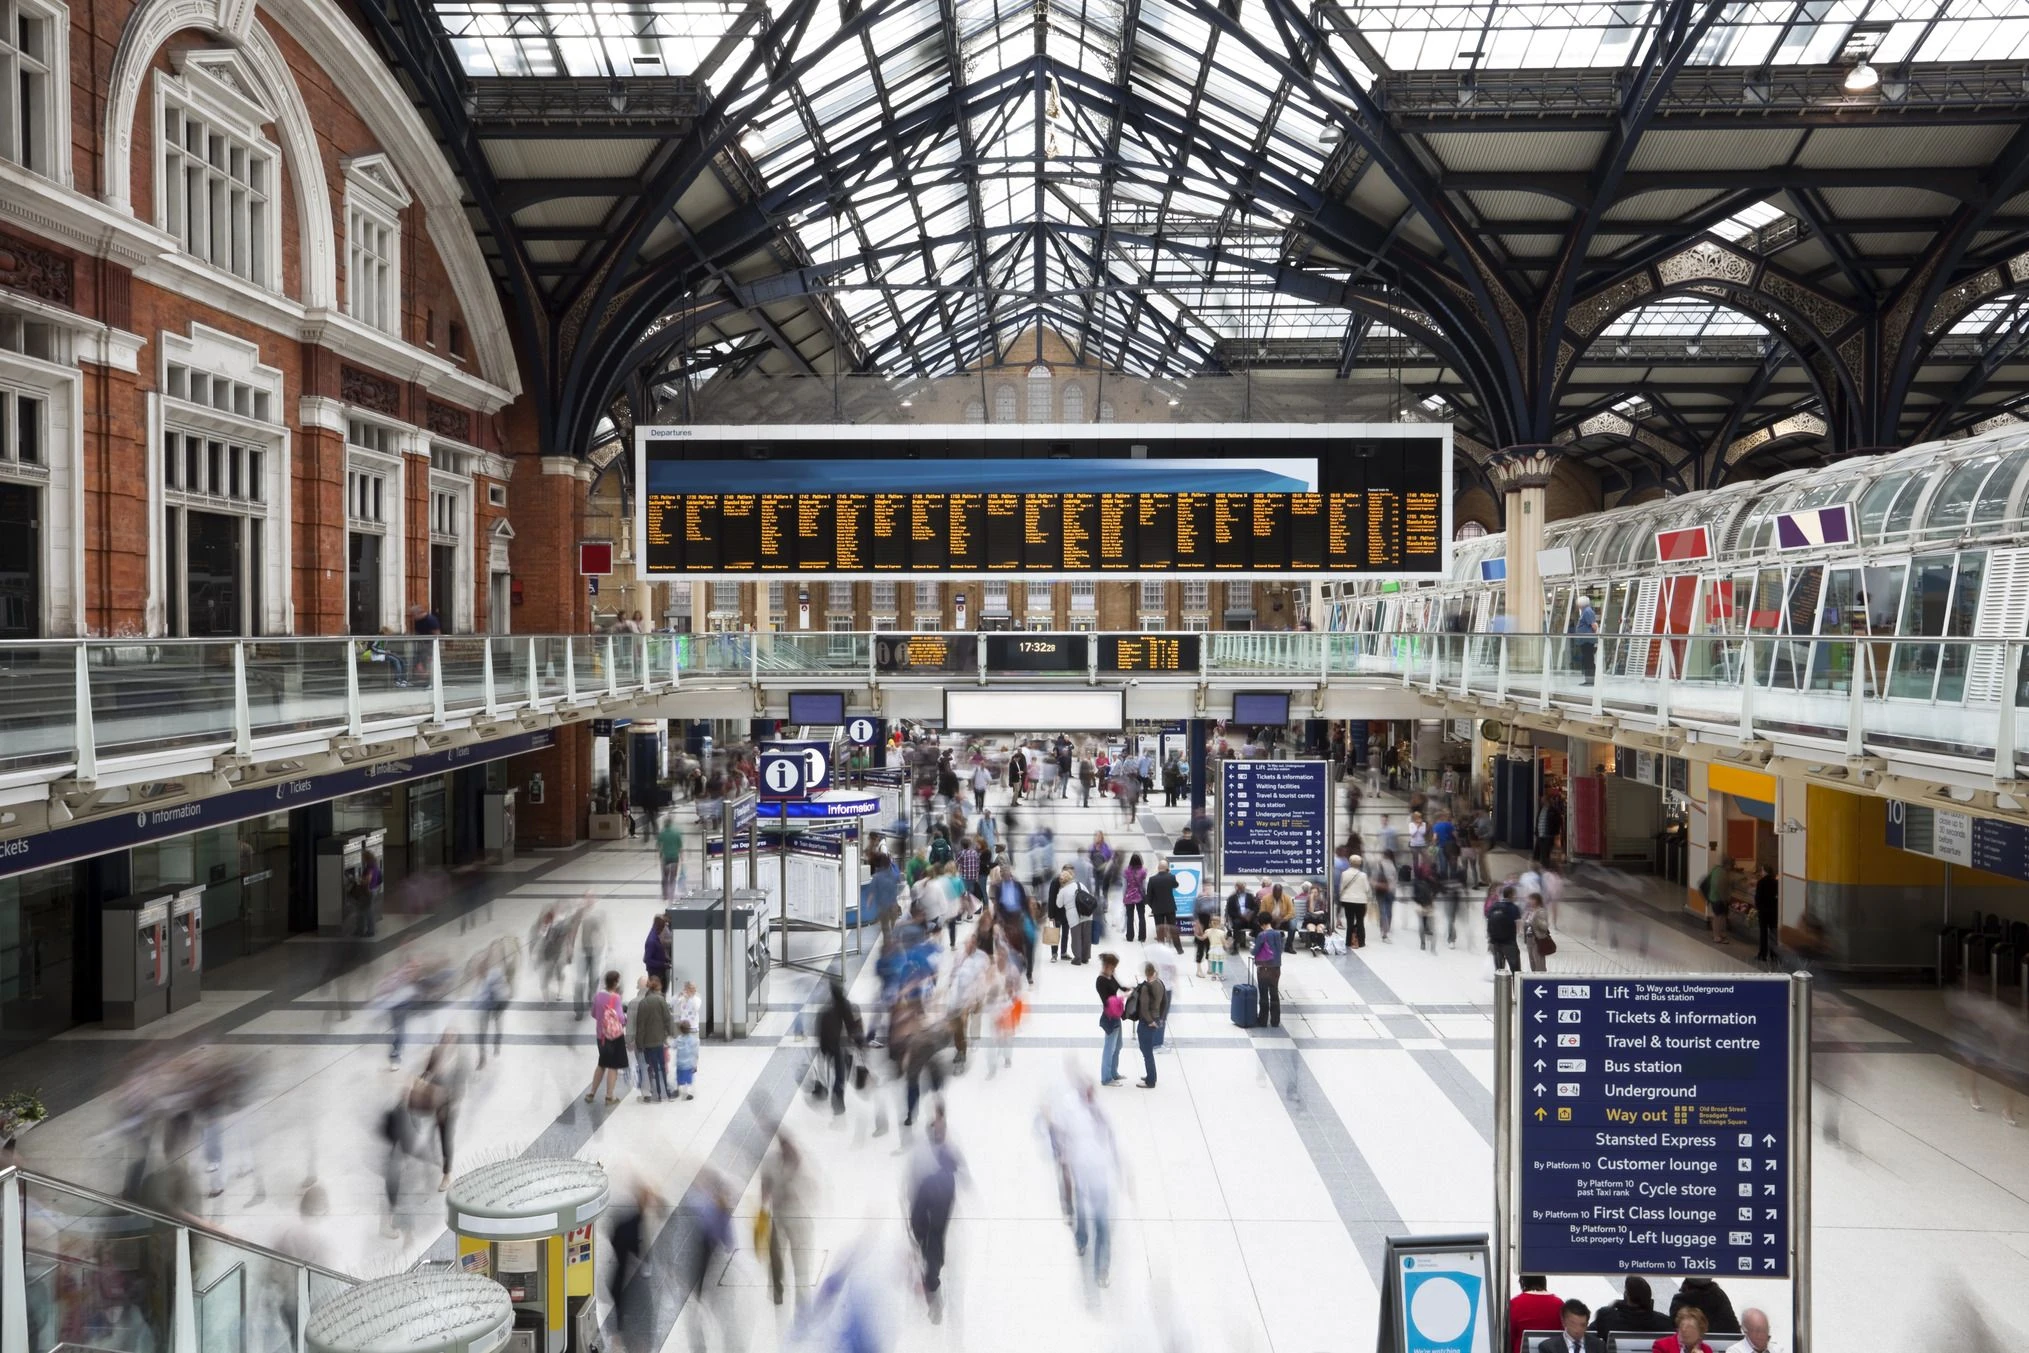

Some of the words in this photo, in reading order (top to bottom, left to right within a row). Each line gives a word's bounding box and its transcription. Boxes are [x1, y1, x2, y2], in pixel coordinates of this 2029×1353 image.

[651, 429, 692, 437] Departures
[289, 780, 312, 795] Tickets
[152, 802, 200, 825] Information
[828, 802, 874, 814] information
[1887, 800, 1902, 824] 10
[1946, 828, 1965, 838] seconds
[1939, 835, 1952, 845] before
[0, 838, 28, 858] ckets
[1939, 846, 1960, 856] departure
[1606, 986, 1629, 998] Lift
[1635, 984, 1644, 992] To
[1647, 985, 1663, 994] Way
[1682, 985, 1734, 994] Underground
[1606, 1010, 1656, 1023] Tickets
[1660, 1011, 1671, 1023] &
[1676, 1011, 1756, 1024] information
[1606, 1035, 1646, 1048] Travel
[1650, 1035, 1662, 1048] &
[1666, 1036, 1711, 1048] tourist
[1716, 1038, 1760, 1049] centre
[1605, 1060, 1630, 1072] Bus
[1634, 1061, 1682, 1072] station
[1605, 1084, 1696, 1100] Underground
[1606, 1108, 1637, 1124] Way
[1642, 1110, 1667, 1121] out
[1596, 1133, 1657, 1146] Stansted
[1662, 1134, 1716, 1149] Express
[1534, 1161, 1544, 1170] By
[1598, 1157, 1666, 1170] Customer
[1670, 1158, 1717, 1173] lounge
[1578, 1180, 1588, 1188] By
[1590, 1180, 1623, 1189] Platform
[1639, 1182, 1677, 1198] Cycle
[1682, 1184, 1716, 1196] store
[1578, 1189, 1594, 1197] past
[1596, 1188, 1611, 1196] Taxi
[1533, 1210, 1543, 1220] By
[1594, 1206, 1624, 1219] First
[1629, 1206, 1664, 1219] Class
[1669, 1207, 1716, 1223] lounge
[1570, 1225, 1580, 1234] By
[1590, 1236, 1624, 1244] property
[1630, 1231, 1657, 1243] Left
[1662, 1232, 1716, 1247] luggage
[1619, 1260, 1629, 1269] By
[1632, 1260, 1664, 1268] Platform
[1681, 1256, 1716, 1269] Taxis
